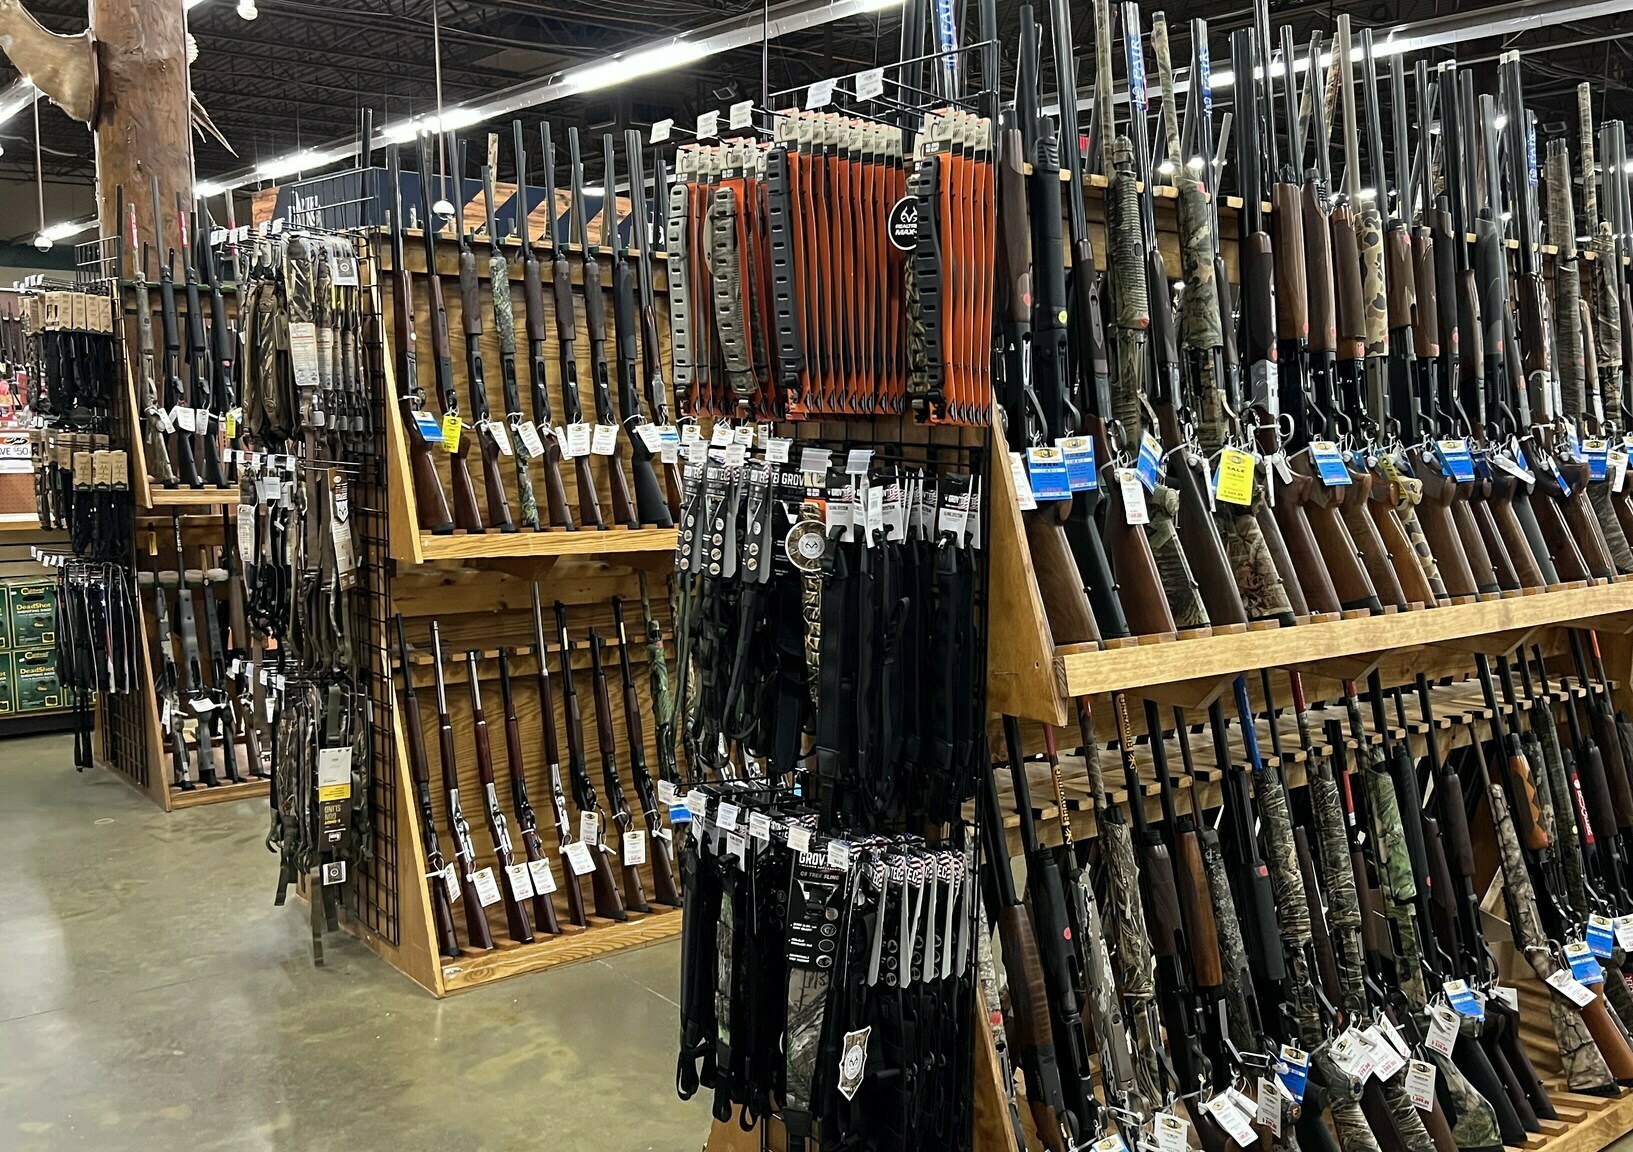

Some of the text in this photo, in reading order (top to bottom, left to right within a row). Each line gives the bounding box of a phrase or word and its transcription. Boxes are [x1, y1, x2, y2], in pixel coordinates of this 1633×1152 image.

[939, 0, 952, 34] FAI
[781, 472, 805, 487] GROV
[16, 602, 51, 611] DeadShot
[20, 667, 55, 675] DeadShot
[1119, 696, 1133, 749] BROWNING
[1054, 768, 1069, 824] BROWNING
[1577, 789, 1593, 836] RUGER
[799, 851, 826, 867] GROV
